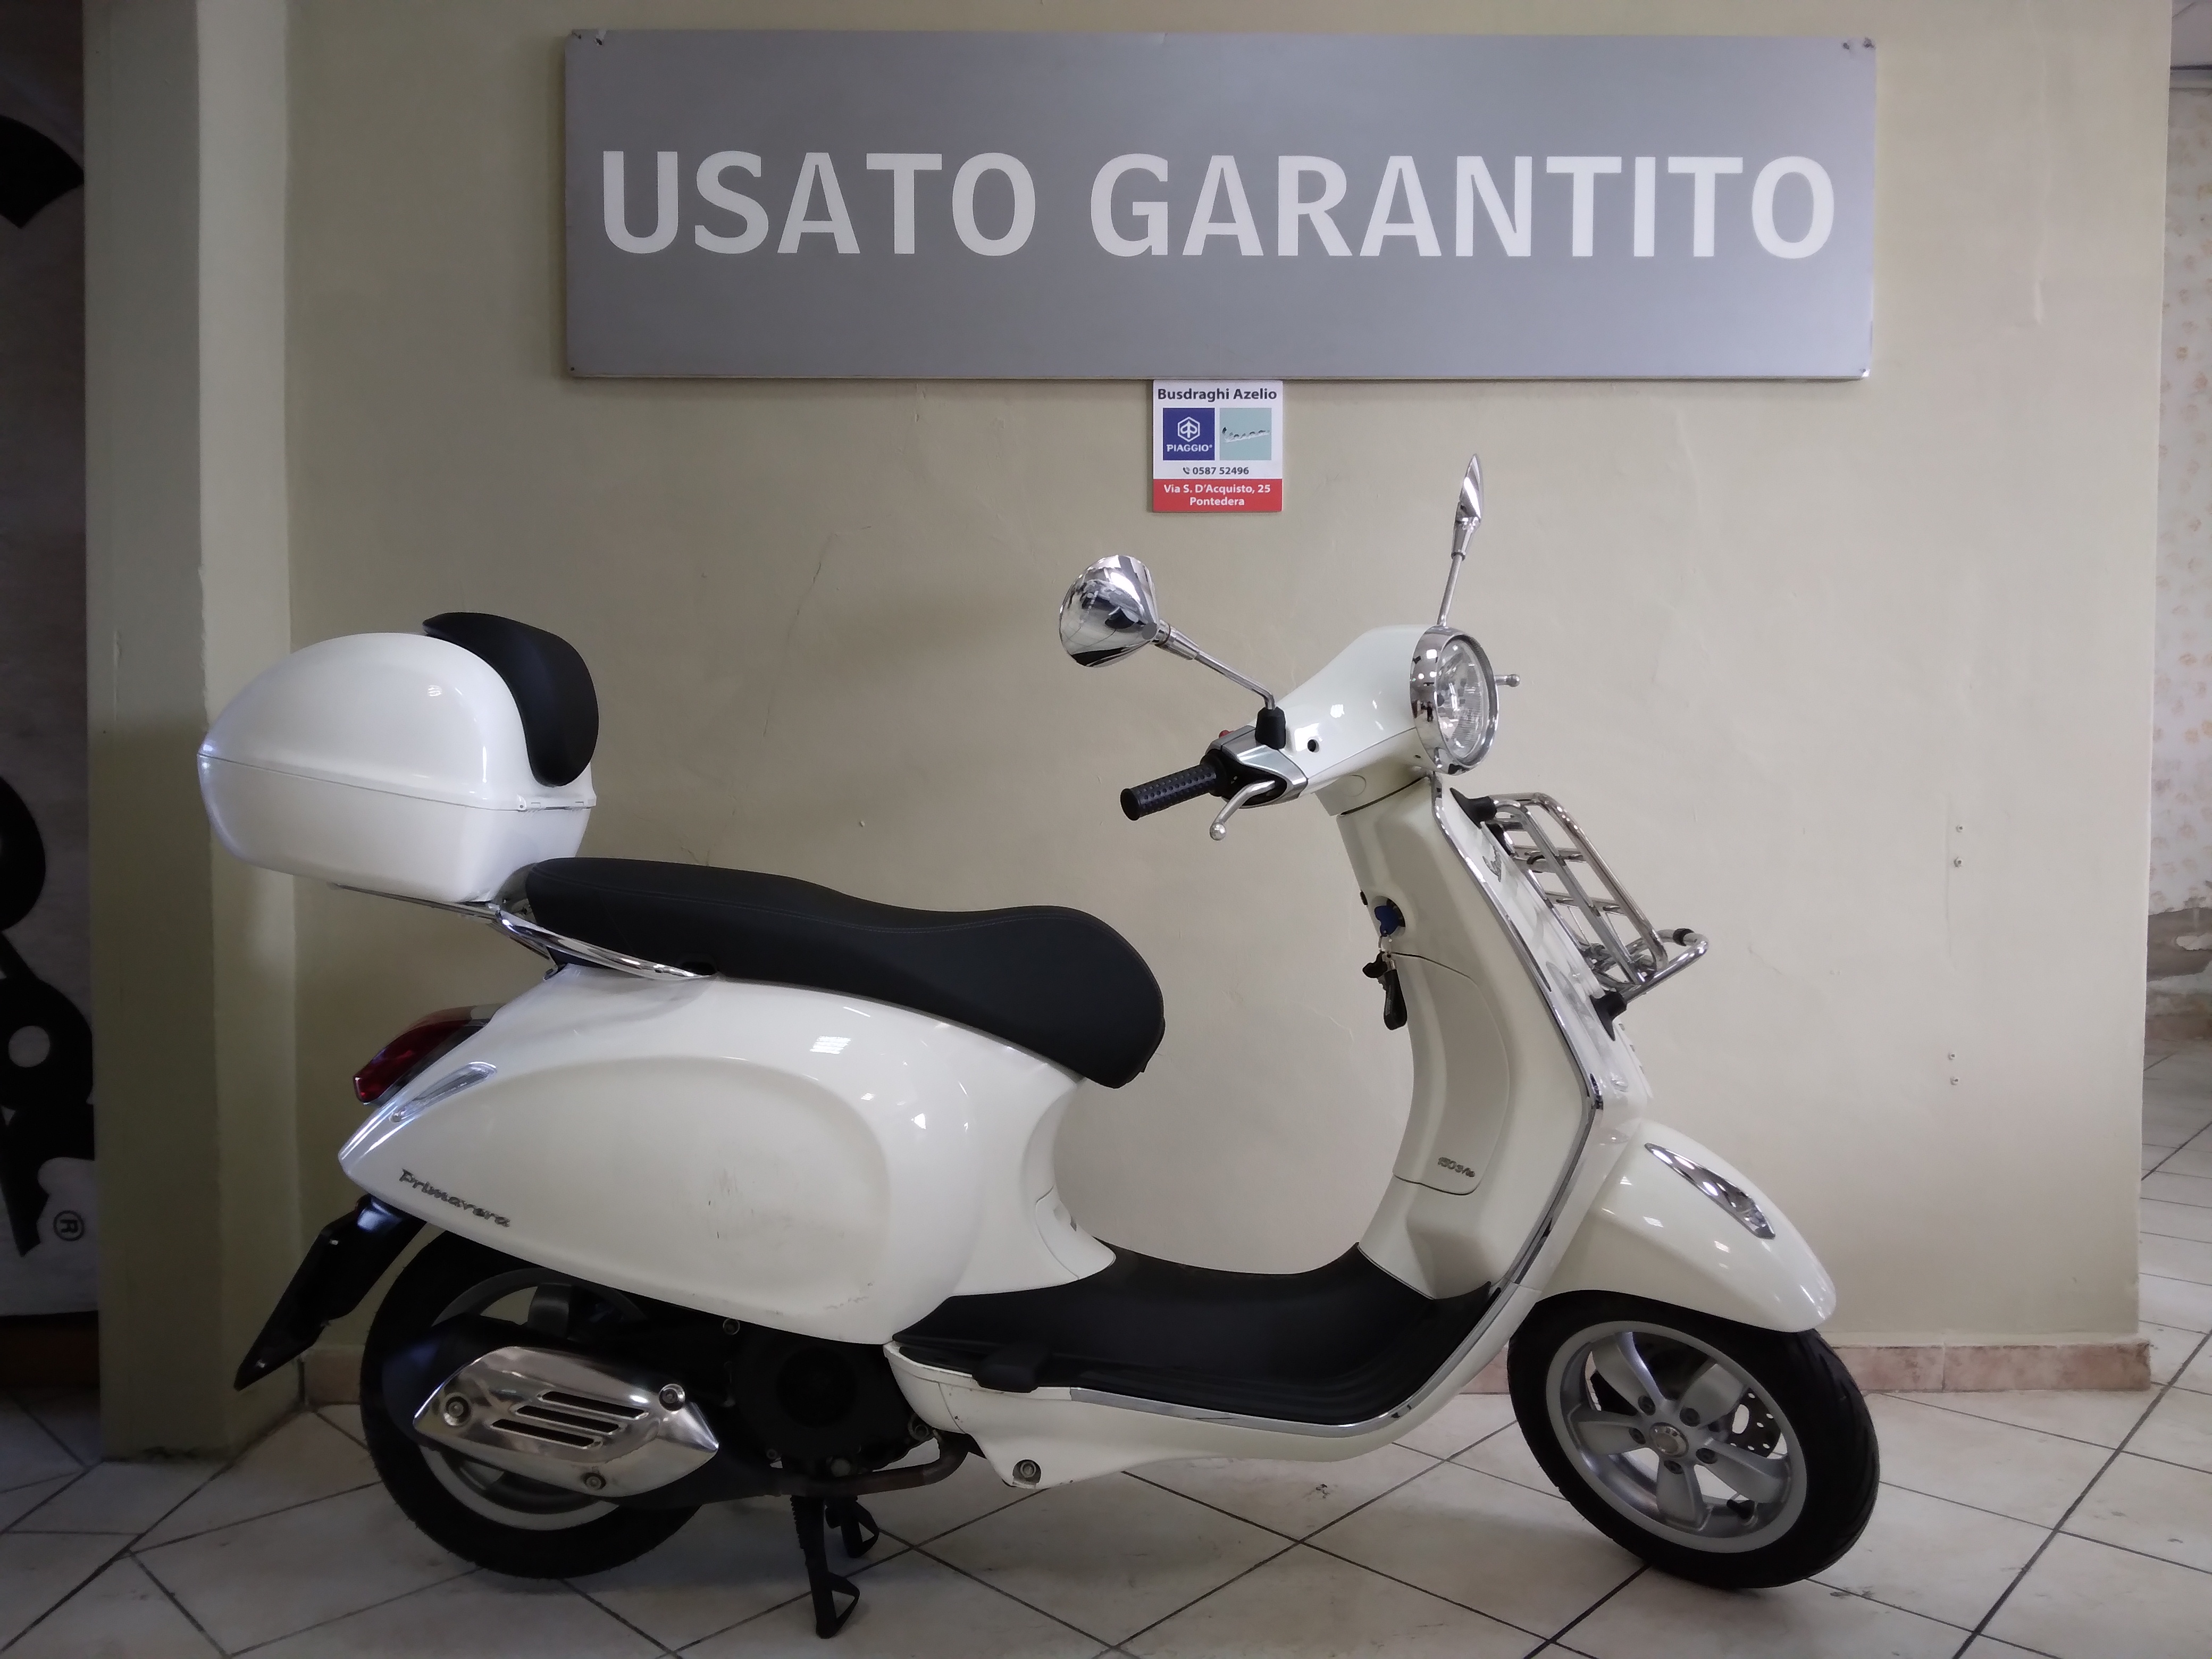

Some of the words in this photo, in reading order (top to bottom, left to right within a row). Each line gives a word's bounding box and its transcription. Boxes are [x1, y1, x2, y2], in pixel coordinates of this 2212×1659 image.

[603, 151, 1036, 256] USATO
[1091, 153, 1834, 259] GARANTITO
[1158, 388, 1229, 403] Busdraghi
[1233, 388, 1277, 400] Azelio
[1163, 484, 1180, 493] Via
[1183, 484, 1193, 493] S.
[1195, 484, 1255, 495] D'Acquisto,
[1258, 484, 1271, 493] 25
[1189, 496, 1245, 506] Pontedera
